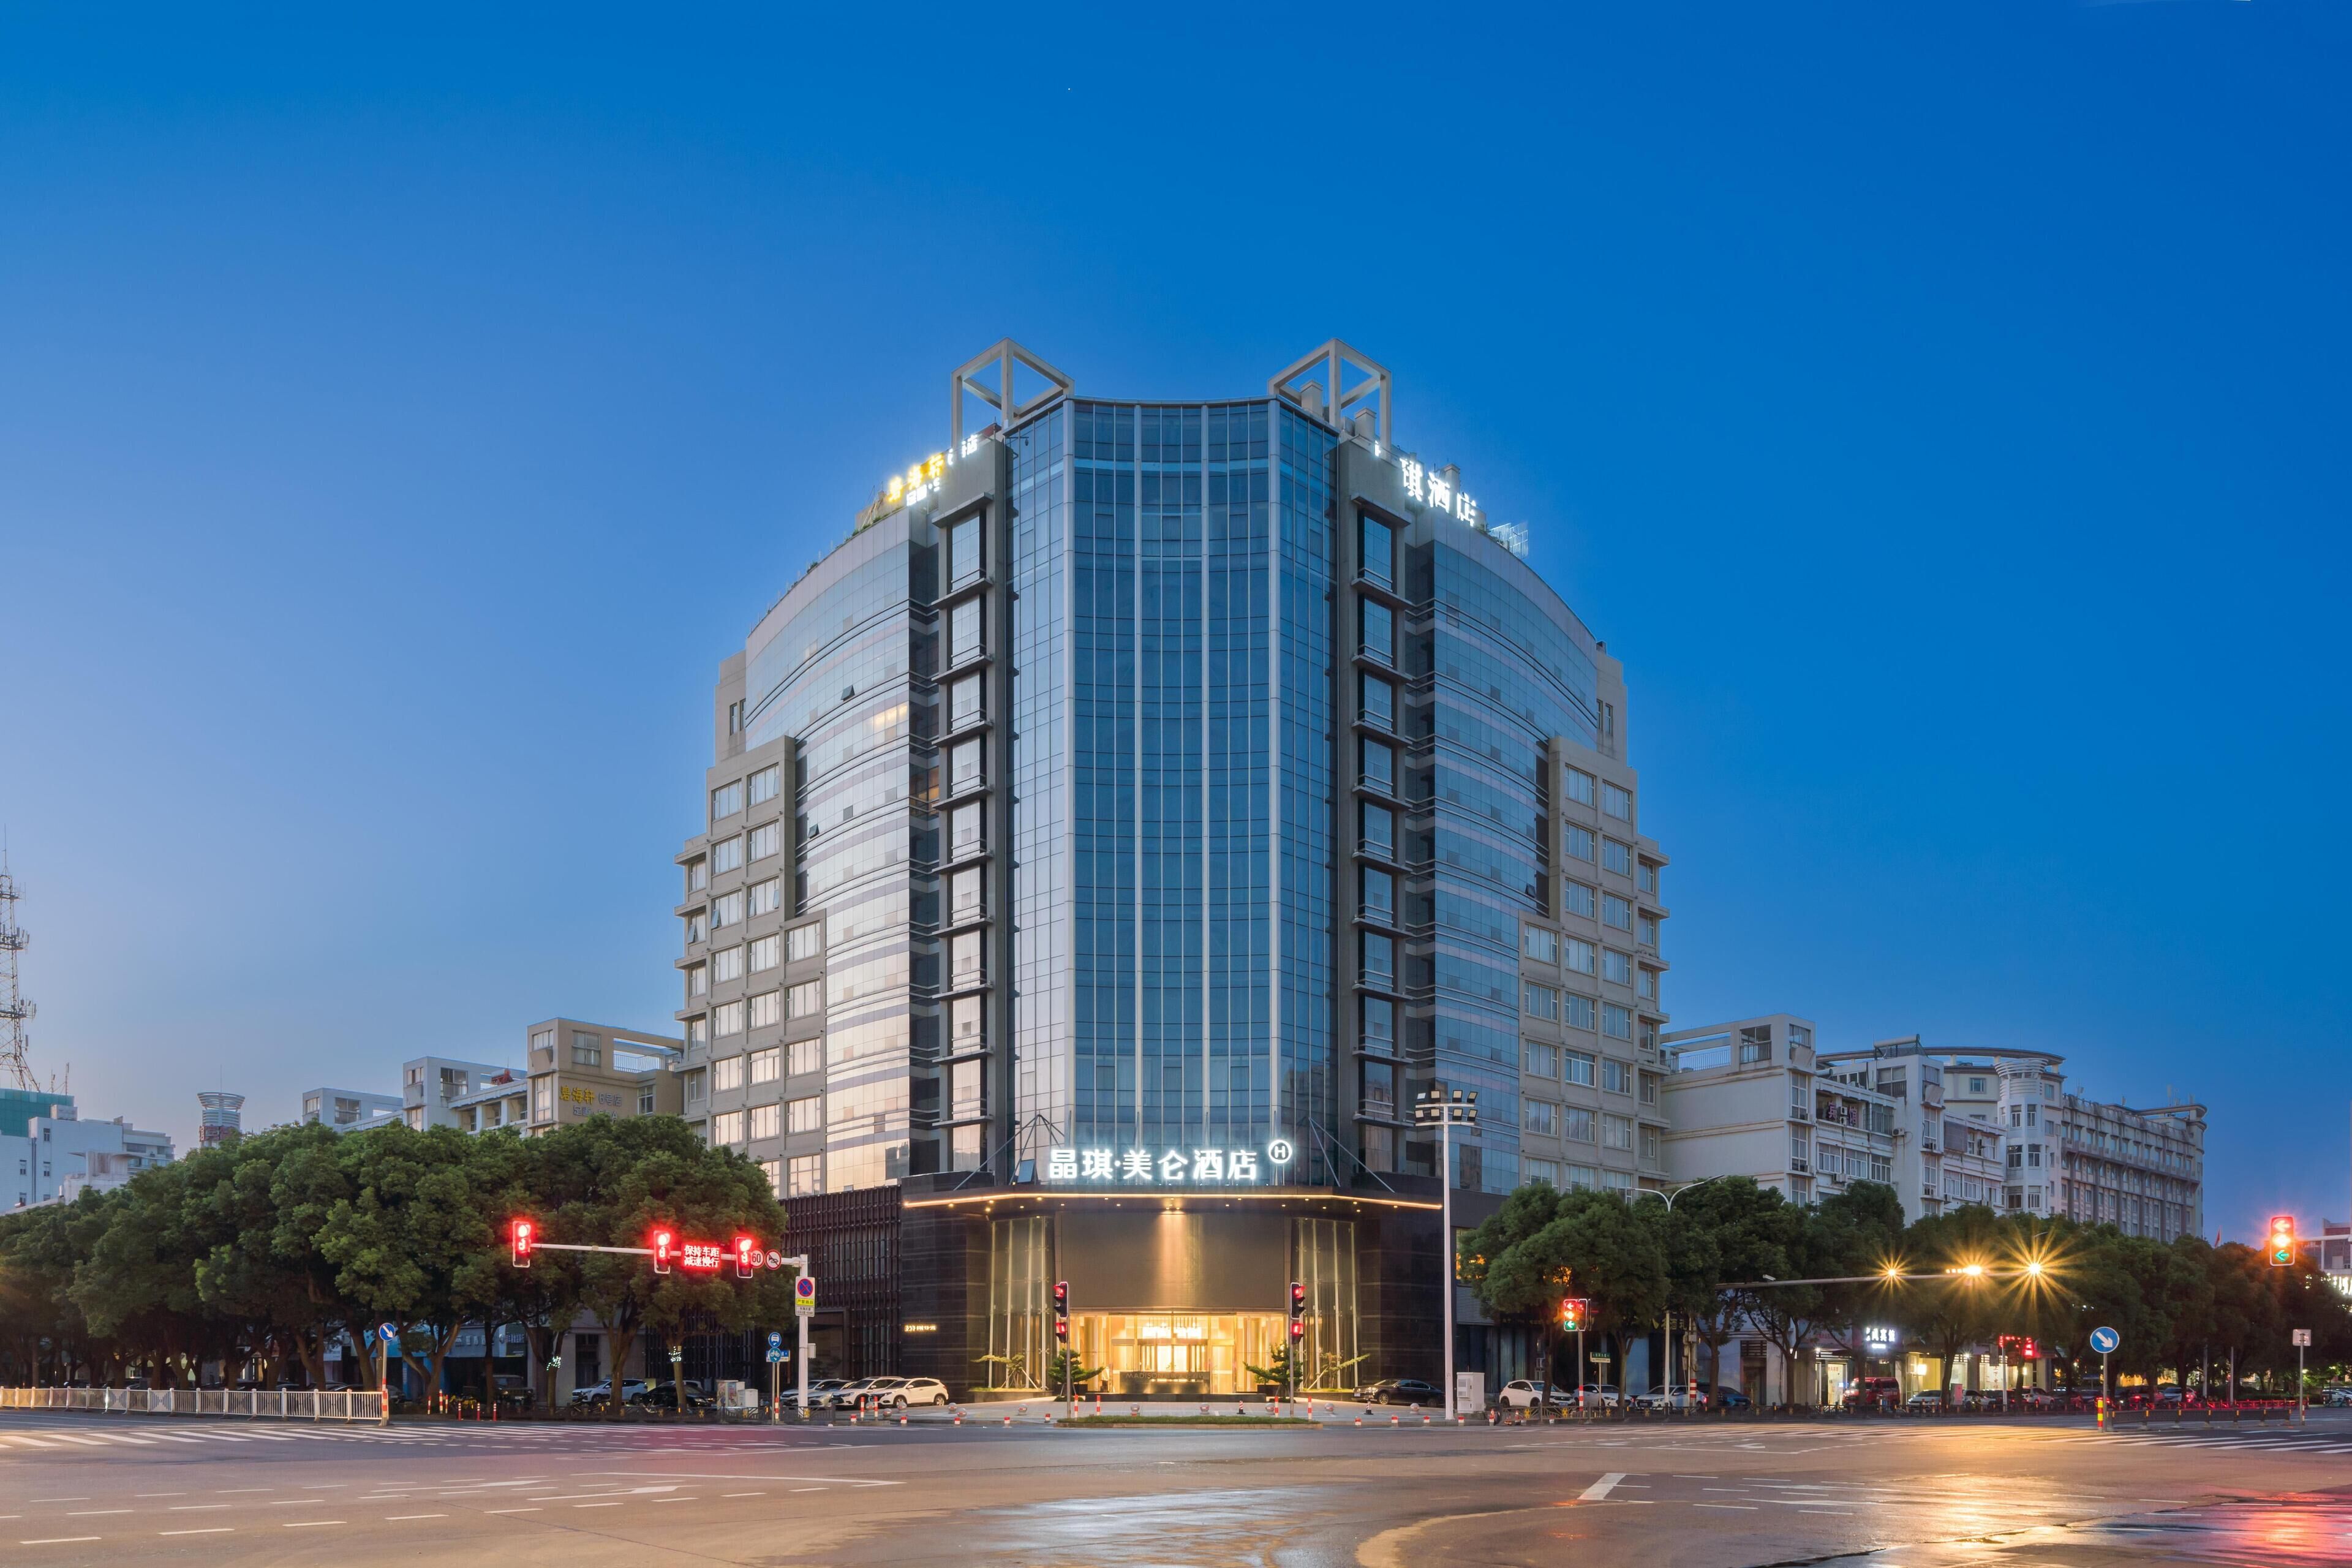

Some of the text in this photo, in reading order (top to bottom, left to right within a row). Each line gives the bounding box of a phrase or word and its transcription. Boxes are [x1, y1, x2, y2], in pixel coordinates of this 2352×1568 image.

[684, 1245, 720, 1257] 保持车距
[684, 1256, 720, 1267] 减速慢行
[752, 1253, 761, 1263] 60
